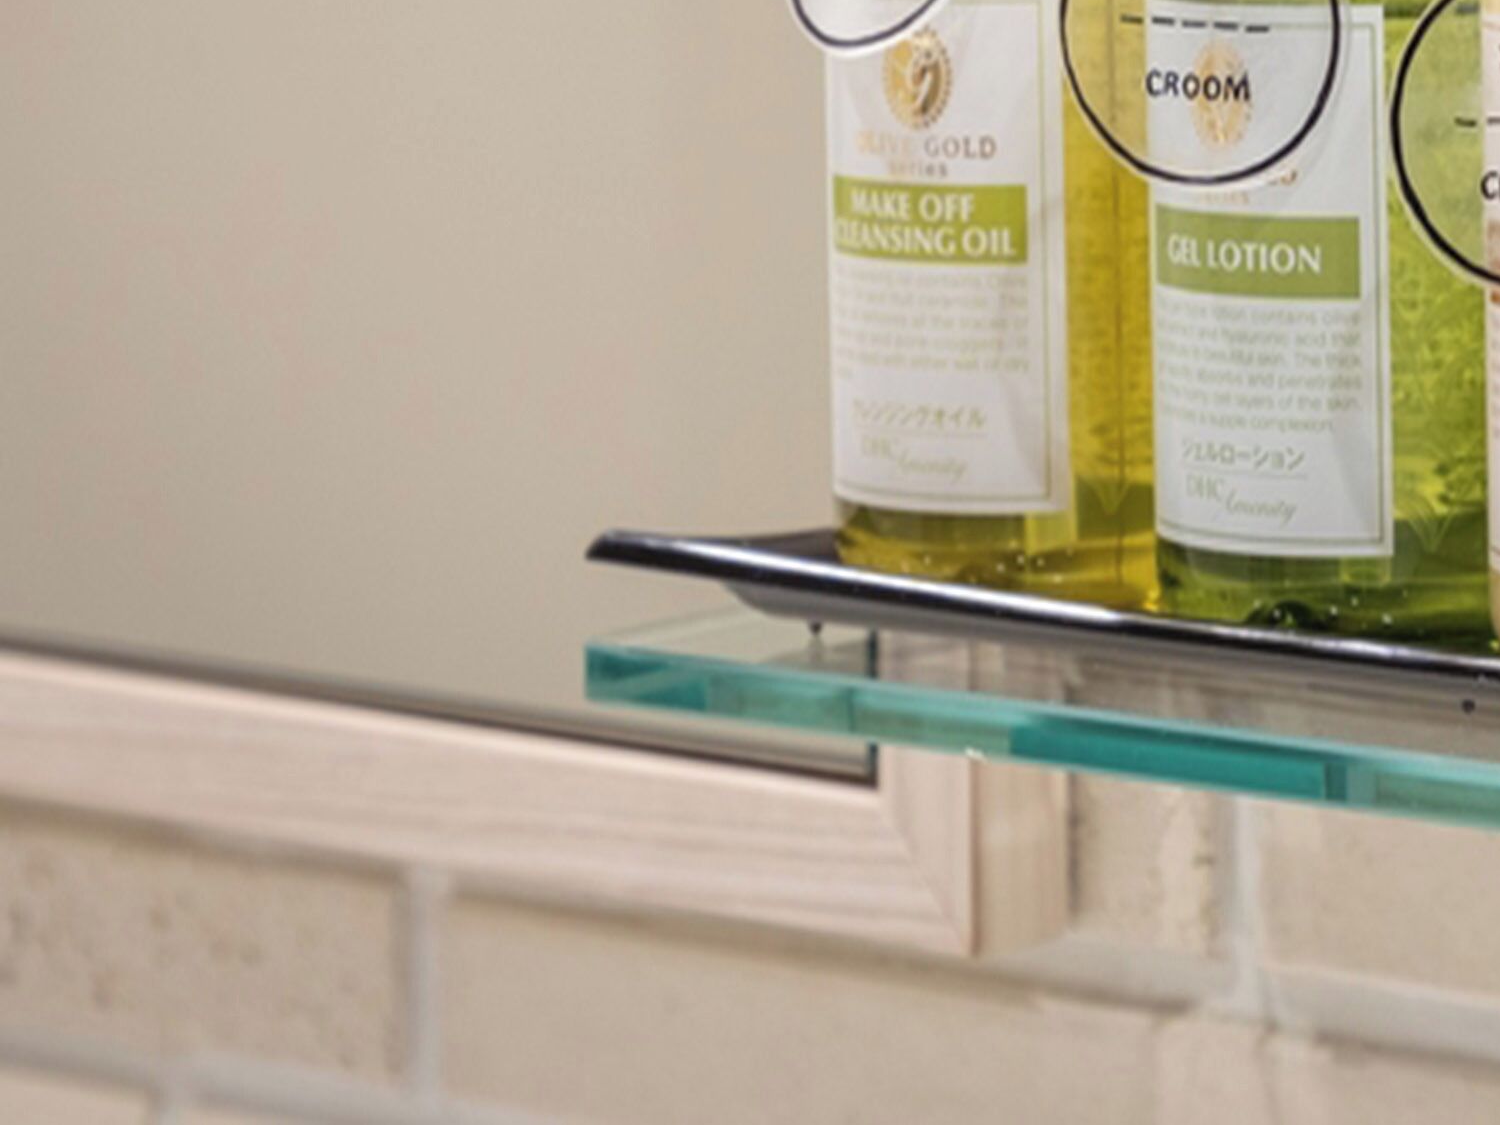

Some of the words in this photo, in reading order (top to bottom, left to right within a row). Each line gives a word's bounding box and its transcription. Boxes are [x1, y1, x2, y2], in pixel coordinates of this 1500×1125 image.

[1145, 69, 1251, 102] CROOM
[923, 136, 997, 161] GOLD
[851, 188, 911, 222] MAKE
[919, 192, 976, 223] OFF
[962, 226, 1017, 257] OIL
[1167, 234, 1201, 268] GEL
[1206, 239, 1323, 274] LOTION
